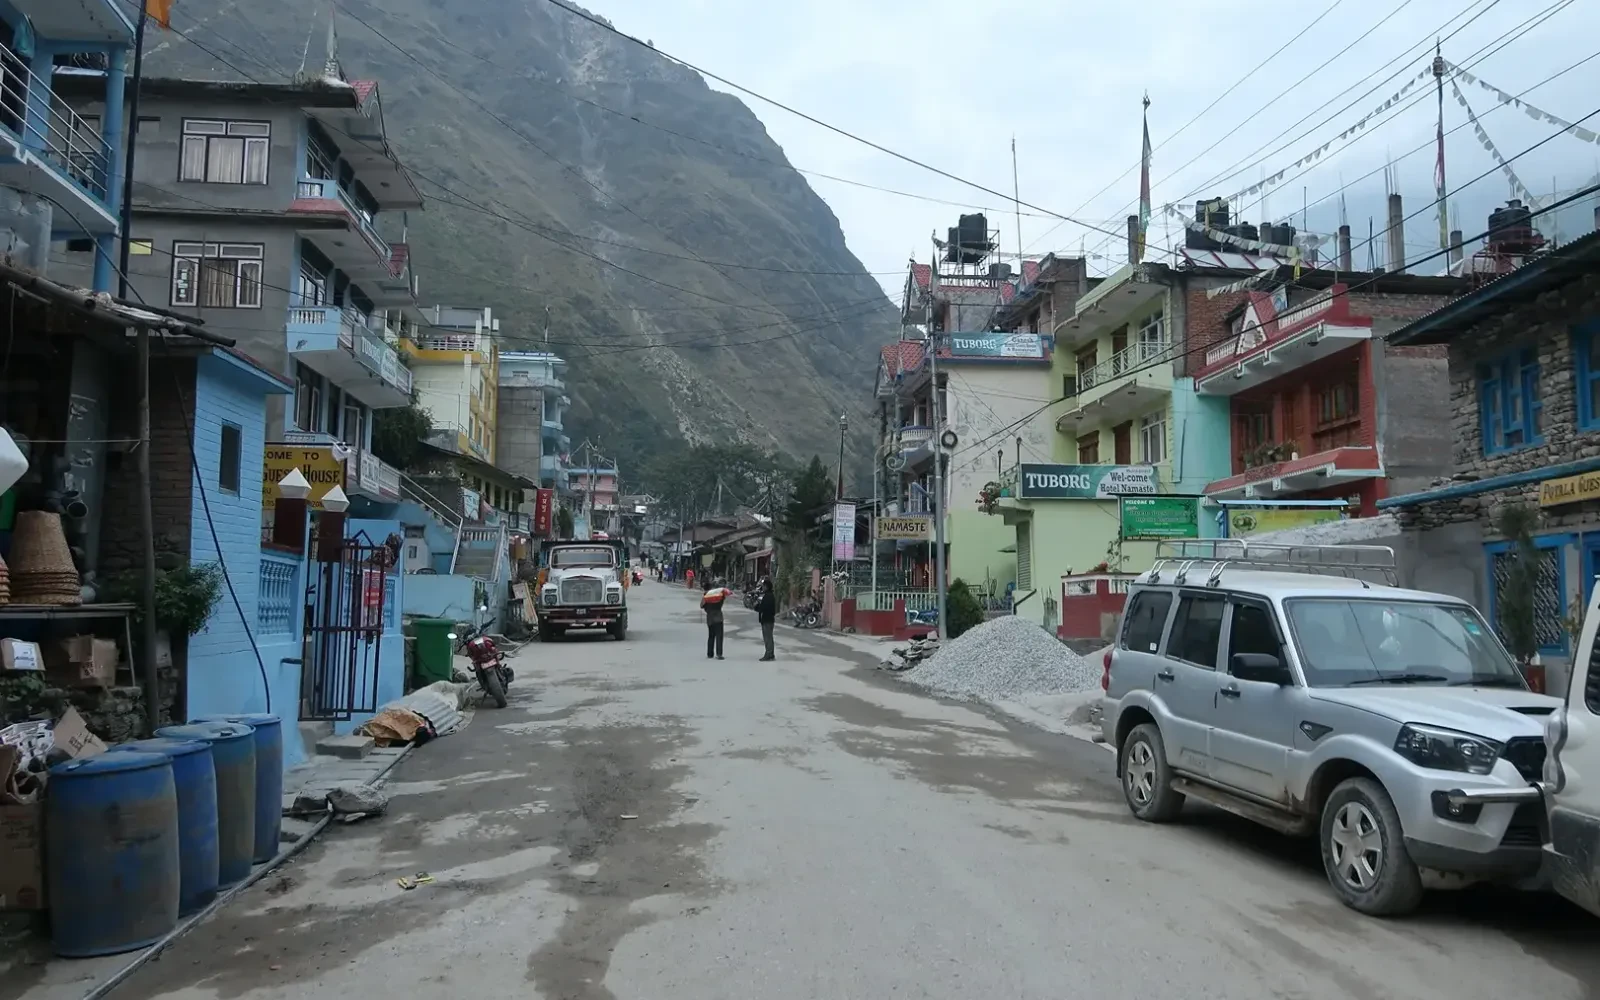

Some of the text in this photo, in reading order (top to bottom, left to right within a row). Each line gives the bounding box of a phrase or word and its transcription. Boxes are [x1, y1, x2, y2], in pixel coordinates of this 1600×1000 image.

[953, 338, 998, 349] TUBORG
[264, 451, 320, 460] OME TO
[1026, 473, 1091, 489] TUBORG
[1110, 472, 1148, 482] Wel-come
[1100, 484, 1153, 493] Hotel Namaste
[883, 522, 926, 532] NAMASTE
